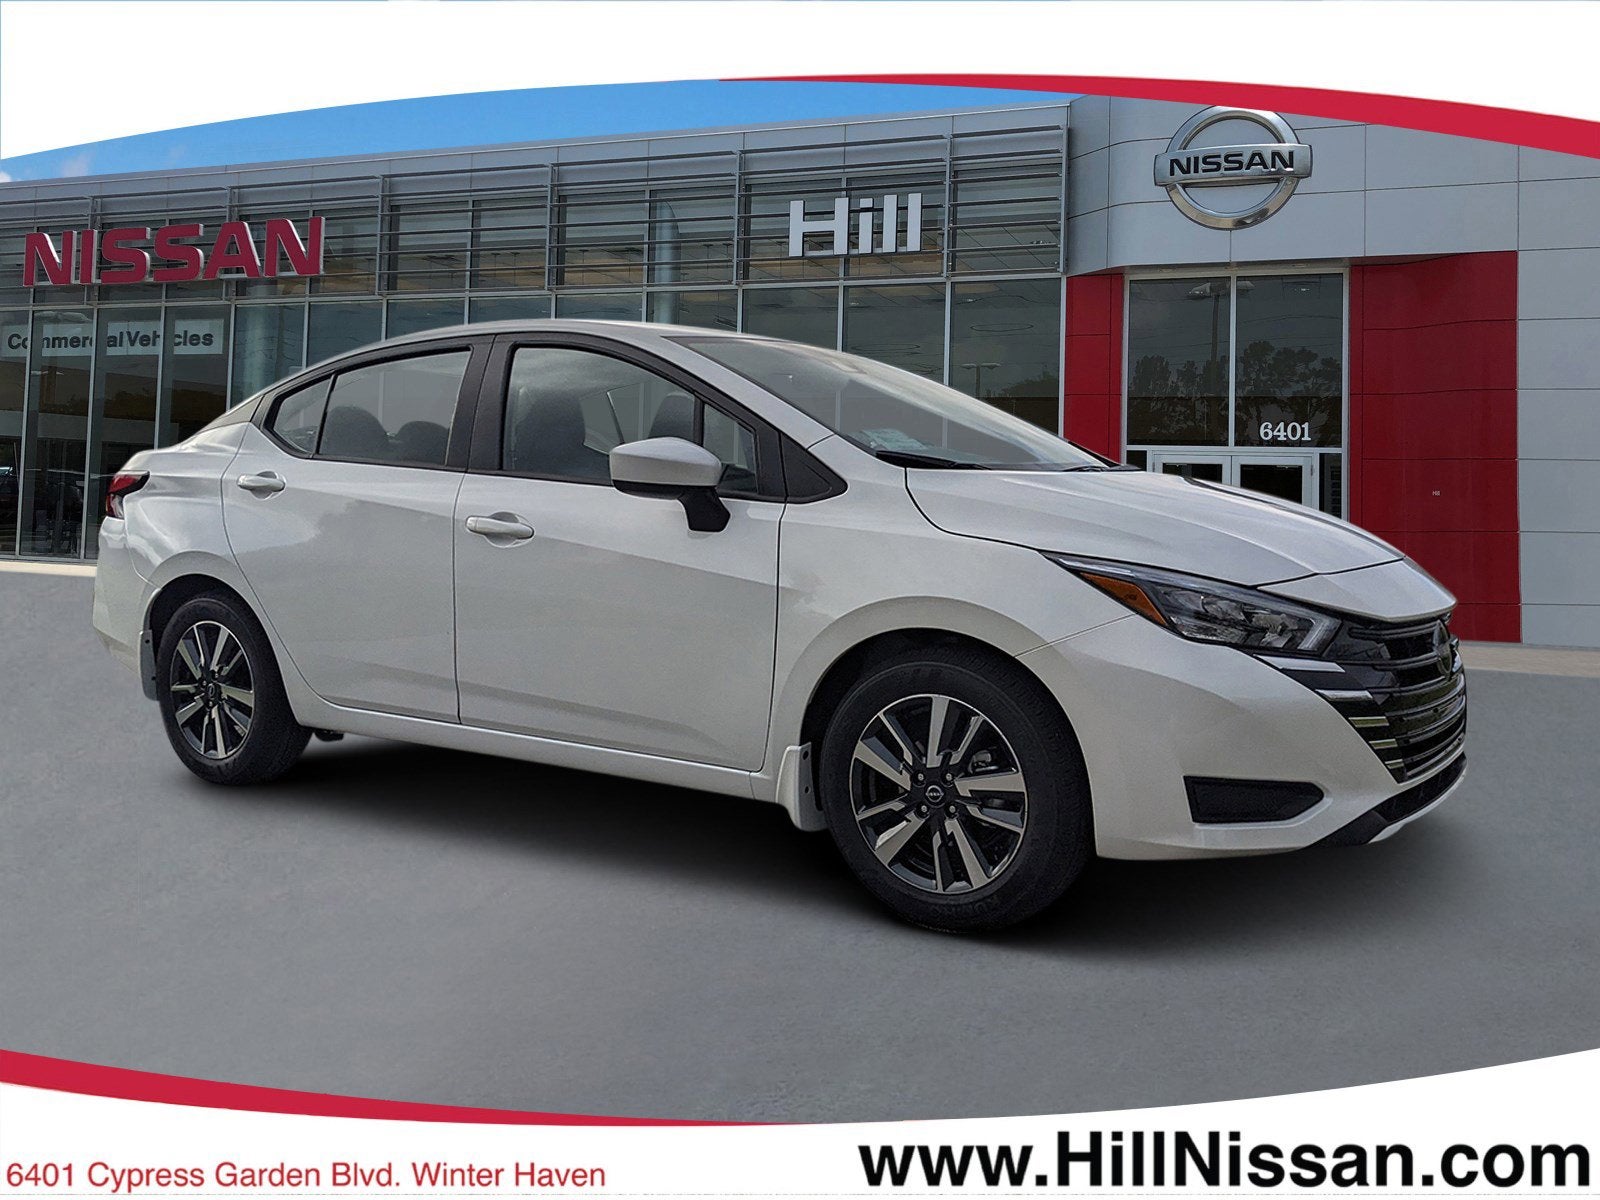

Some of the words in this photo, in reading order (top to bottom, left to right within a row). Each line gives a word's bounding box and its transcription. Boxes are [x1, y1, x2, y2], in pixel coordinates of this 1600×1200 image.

[1169, 151, 1295, 177] NISSAN
[788, 192, 922, 257] Hill
[23, 216, 325, 286] NISSAN
[7, 331, 124, 349] Comeral
[126, 330, 214, 347] Vehcles
[1259, 421, 1312, 441] 6401
